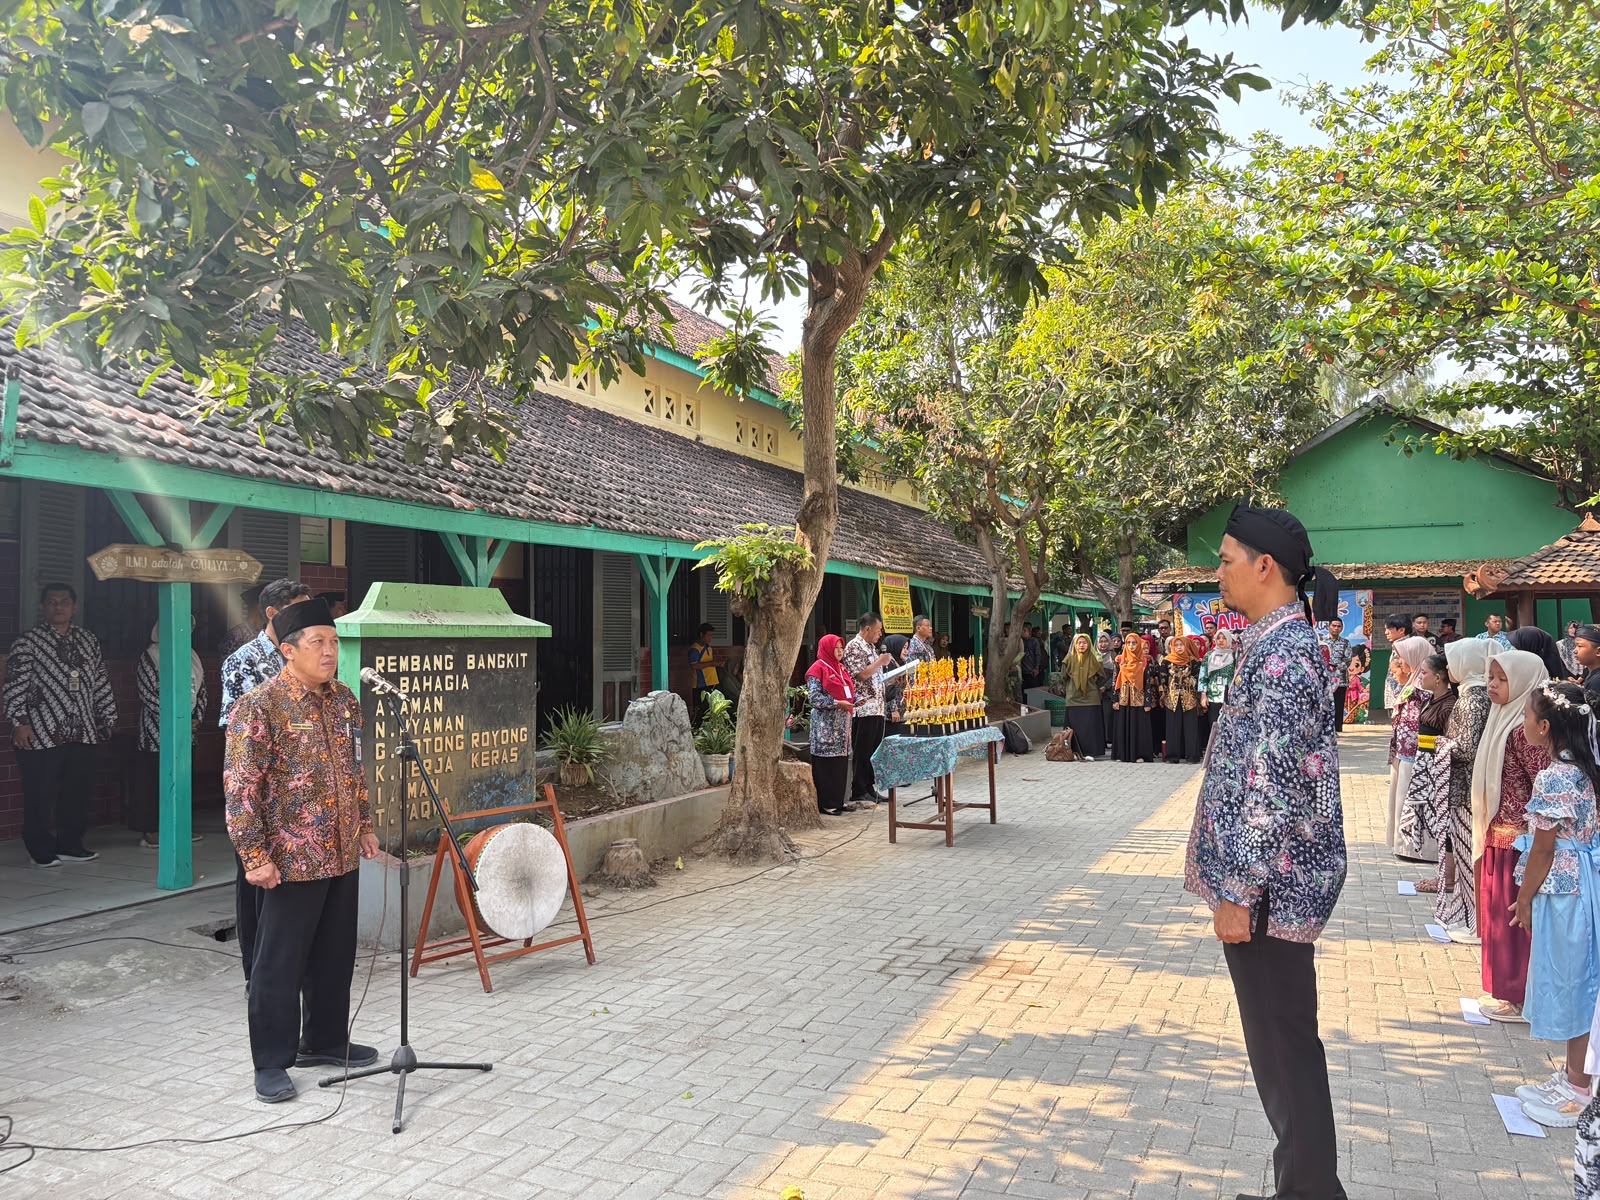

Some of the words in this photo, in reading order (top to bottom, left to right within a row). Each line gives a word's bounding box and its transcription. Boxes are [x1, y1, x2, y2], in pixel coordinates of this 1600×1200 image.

[126, 556, 147, 568] ILMU
[375, 655, 454, 673] REMBANG
[467, 652, 528, 670] BANGKIT
[400, 674, 469, 693] BAHAGIA
[471, 726, 528, 749] ROYONG
[471, 746, 518, 769] KERAS
